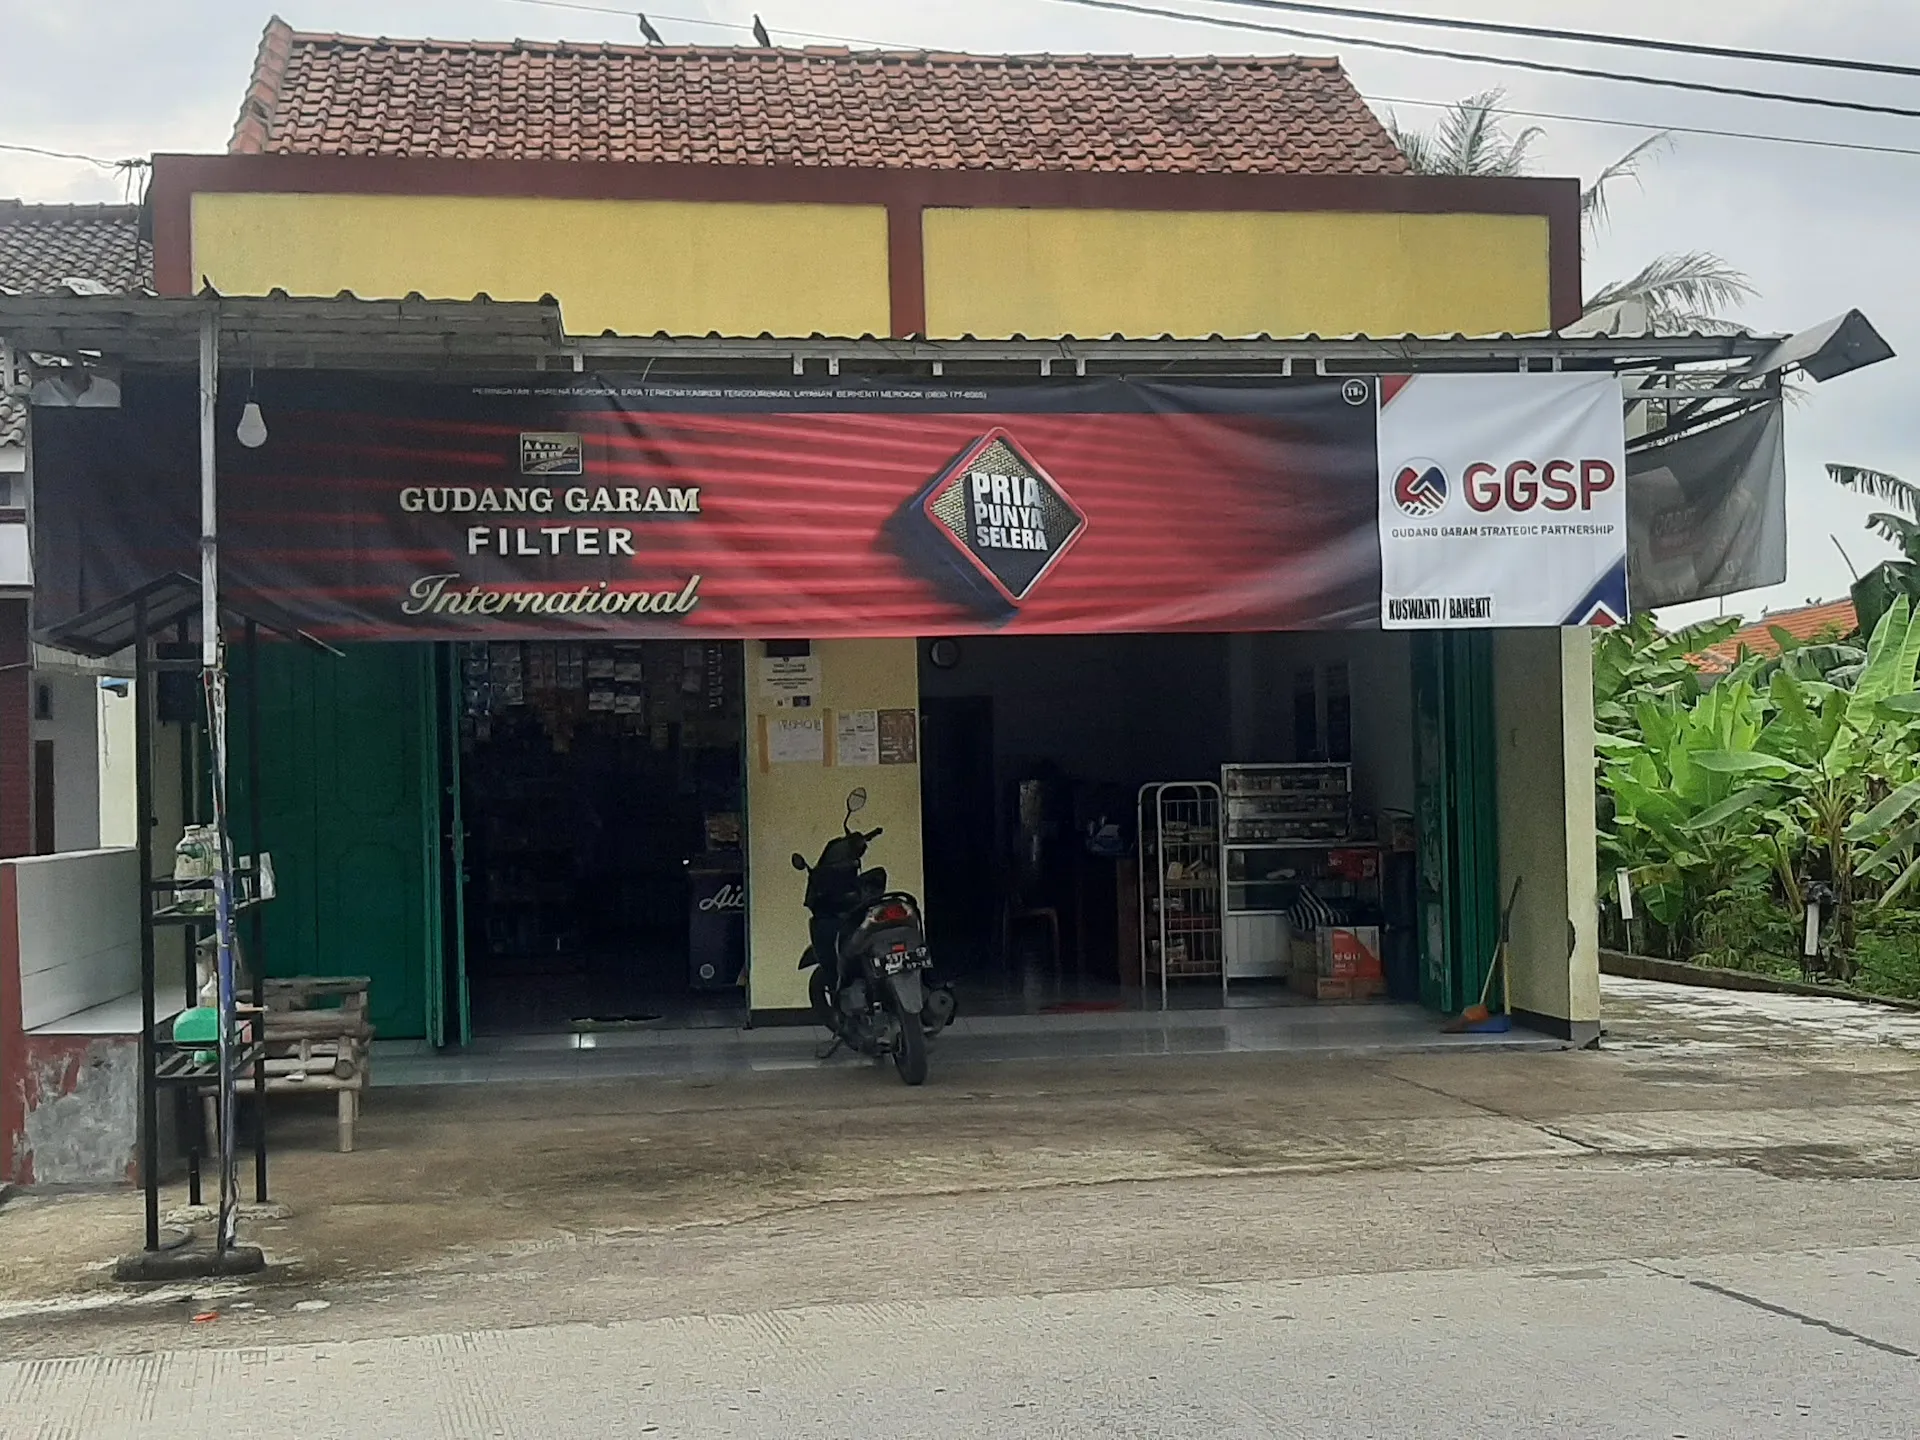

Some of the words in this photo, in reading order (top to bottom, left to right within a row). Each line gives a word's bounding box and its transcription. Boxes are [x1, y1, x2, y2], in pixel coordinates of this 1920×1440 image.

[970, 472, 1044, 508] PRIA
[1463, 459, 1615, 513] GGSP
[399, 487, 554, 512] GUDANG
[564, 487, 701, 513] GARAM
[974, 503, 1045, 530] PUNYA
[467, 526, 636, 556] FILTER
[976, 526, 1048, 551] SELERA
[1391, 528, 1438, 538] GUDANG
[1441, 527, 1478, 537] GARAM
[1480, 526, 1538, 537] STRATEGIC
[1540, 525, 1615, 536] PARTNERSHIP
[401, 573, 701, 615] International
[1388, 598, 1441, 620] KUSWANTI
[1449, 596, 1491, 619] BANGKIT
[699, 884, 745, 911] Aic
